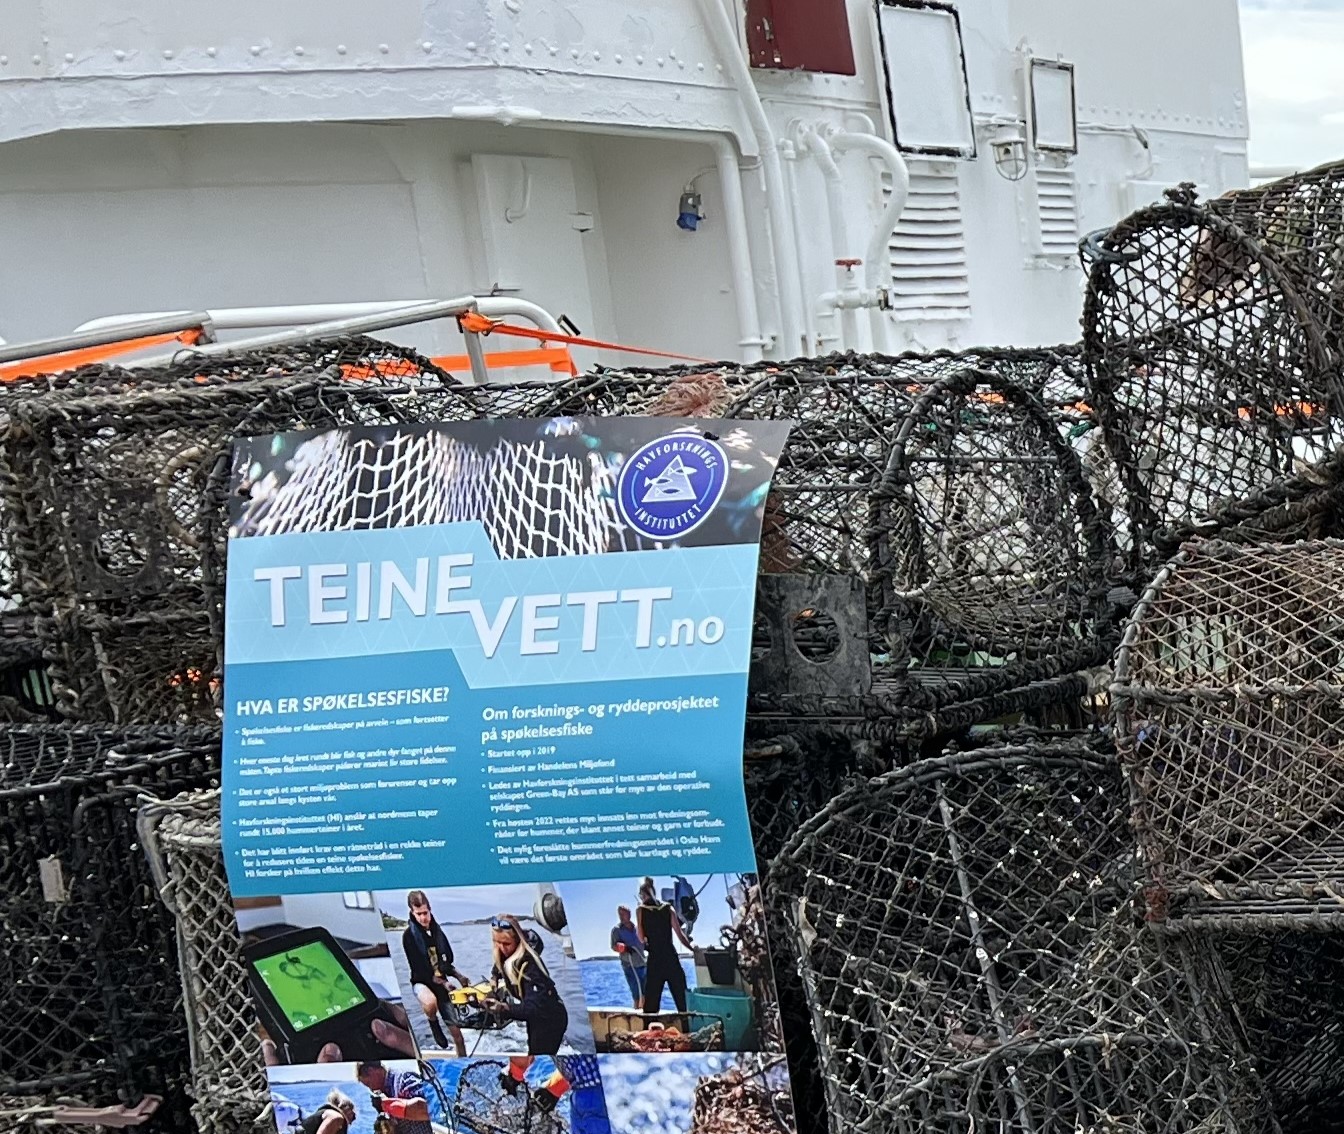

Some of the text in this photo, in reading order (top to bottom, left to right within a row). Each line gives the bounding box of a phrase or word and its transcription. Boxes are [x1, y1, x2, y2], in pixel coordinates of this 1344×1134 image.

[635, 441, 718, 473] HAVFORSKNINGS
[633, 503, 703, 535] INSTITUTTET
[253, 553, 475, 626] TEINE
[469, 586, 725, 659] VETT.no
[236, 686, 450, 716] HVA ER SPØKELSESFISKE?
[482, 695, 720, 721] Om forsknings- og ryddeprosjektet
[481, 722, 593, 744] på spøkelsesfiske
